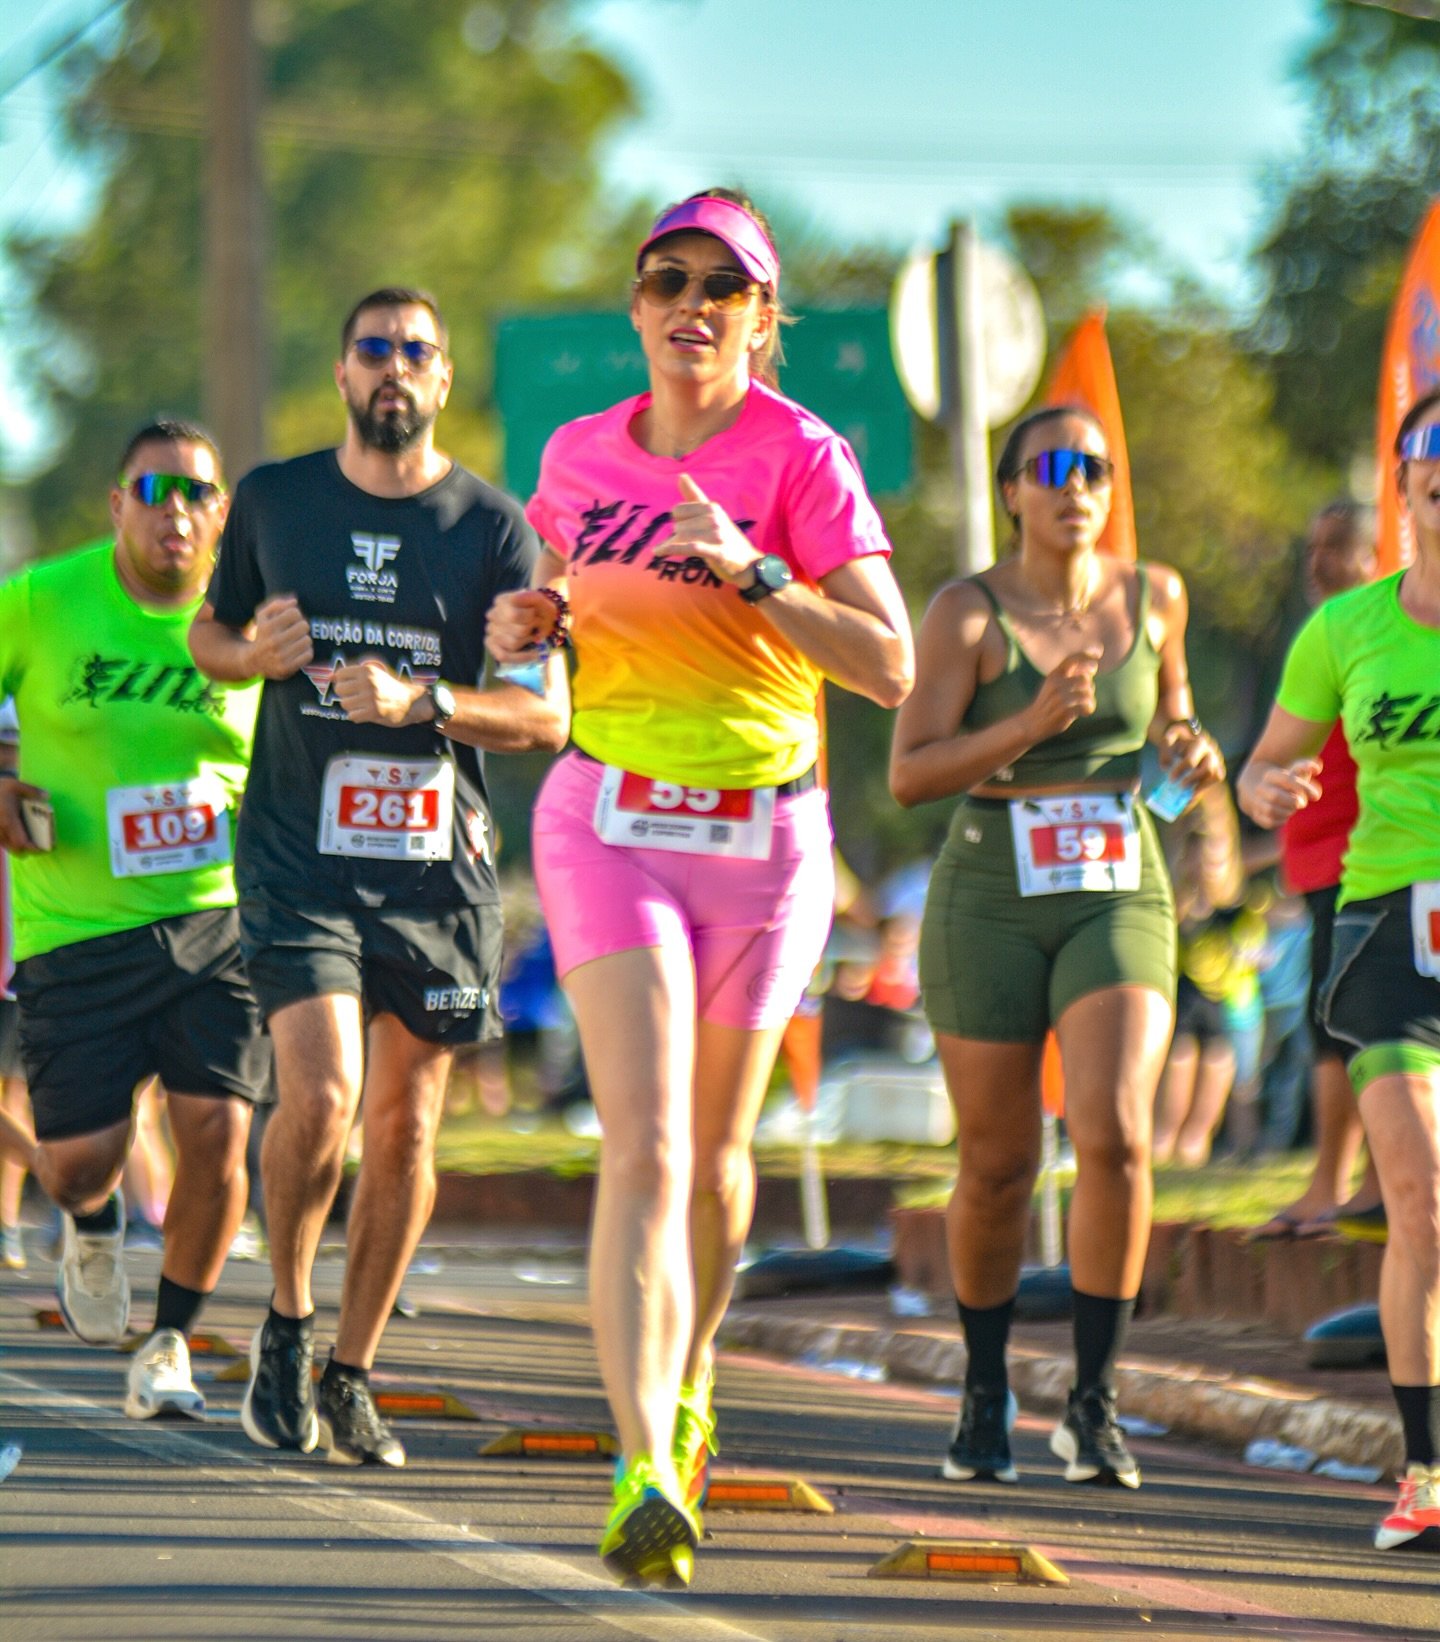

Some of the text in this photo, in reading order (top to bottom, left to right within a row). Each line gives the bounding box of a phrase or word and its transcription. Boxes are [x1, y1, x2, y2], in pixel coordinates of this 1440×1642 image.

[348, 571, 398, 588] FORJA
[312, 622, 440, 652] EDIÇÃO DA CORRIDA
[353, 793, 428, 827] 261
[650, 778, 720, 813] 55
[135, 811, 207, 847] 109
[1056, 827, 1106, 861] 59
